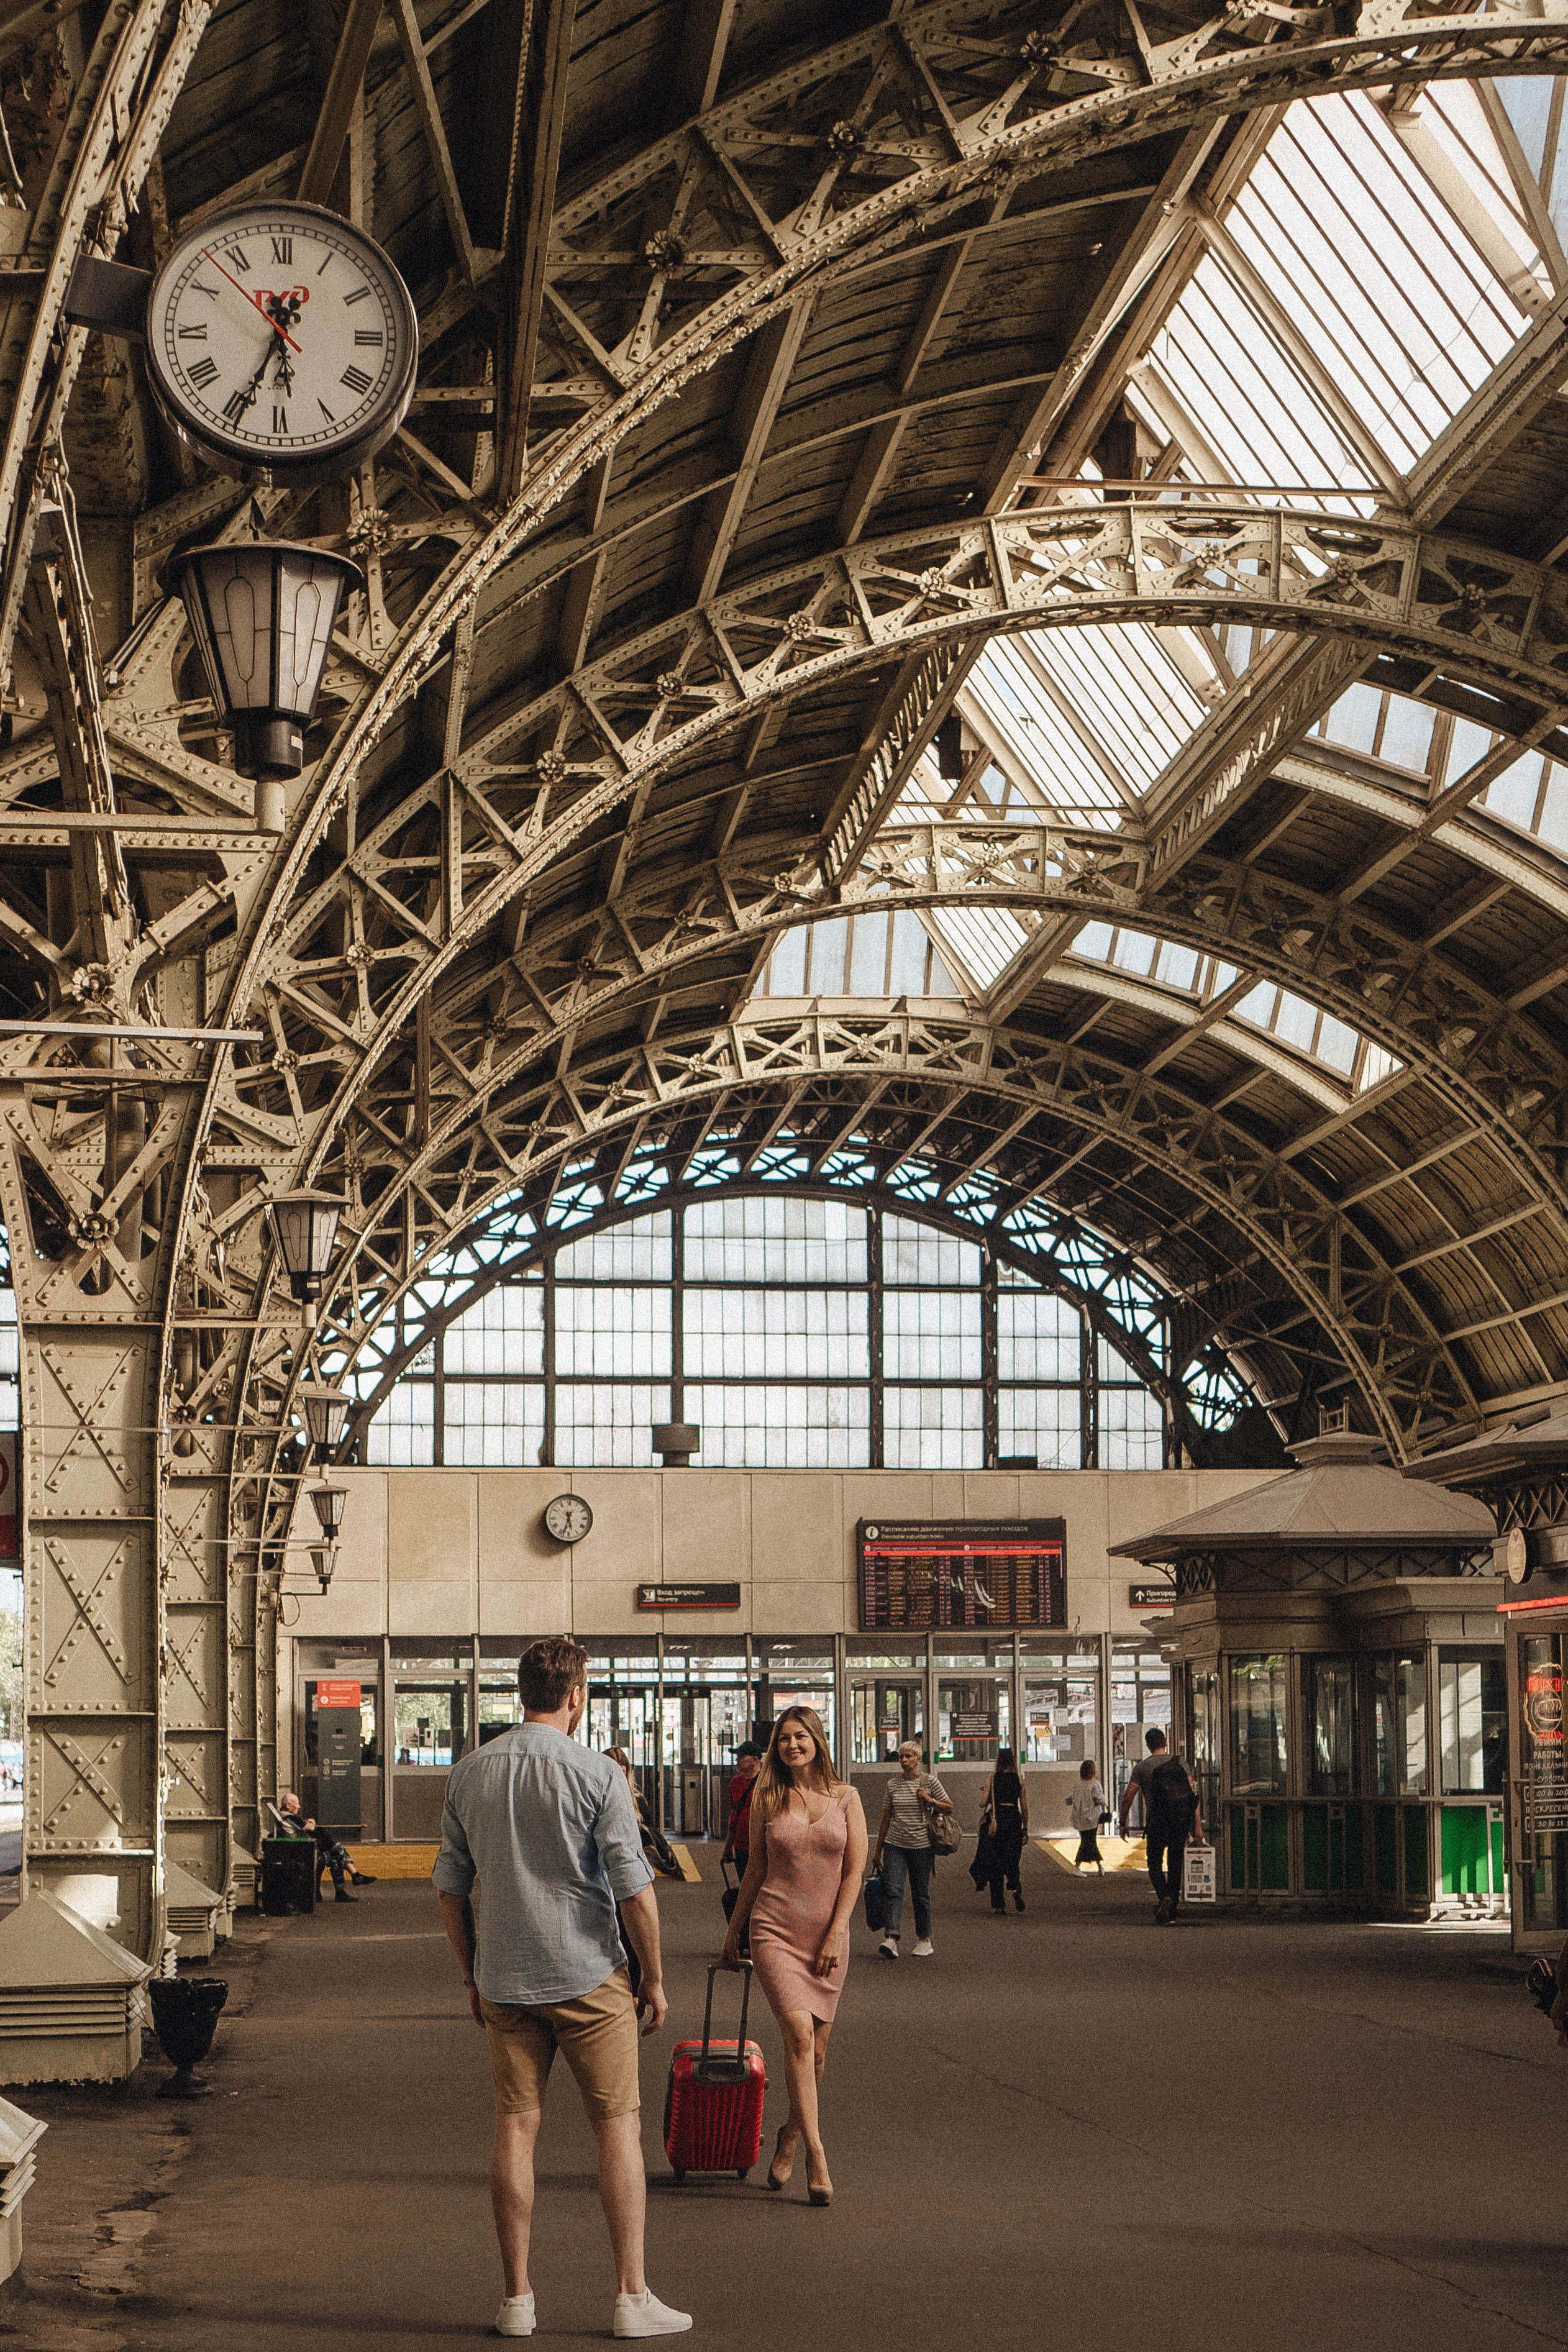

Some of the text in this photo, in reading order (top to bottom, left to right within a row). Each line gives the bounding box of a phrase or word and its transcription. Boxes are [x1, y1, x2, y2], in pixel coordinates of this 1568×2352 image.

[224, 245, 251, 275] XI
[271, 237, 293, 265] XII
[316, 251, 334, 276] I
[191, 279, 221, 301] X
[342, 285, 371, 307] II
[179, 323, 208, 341] IX
[355, 329, 383, 347] III
[186, 357, 221, 392] VIII
[339, 364, 373, 396] IIII
[272, 406, 289, 434] VI
[317, 398, 336, 424] V
